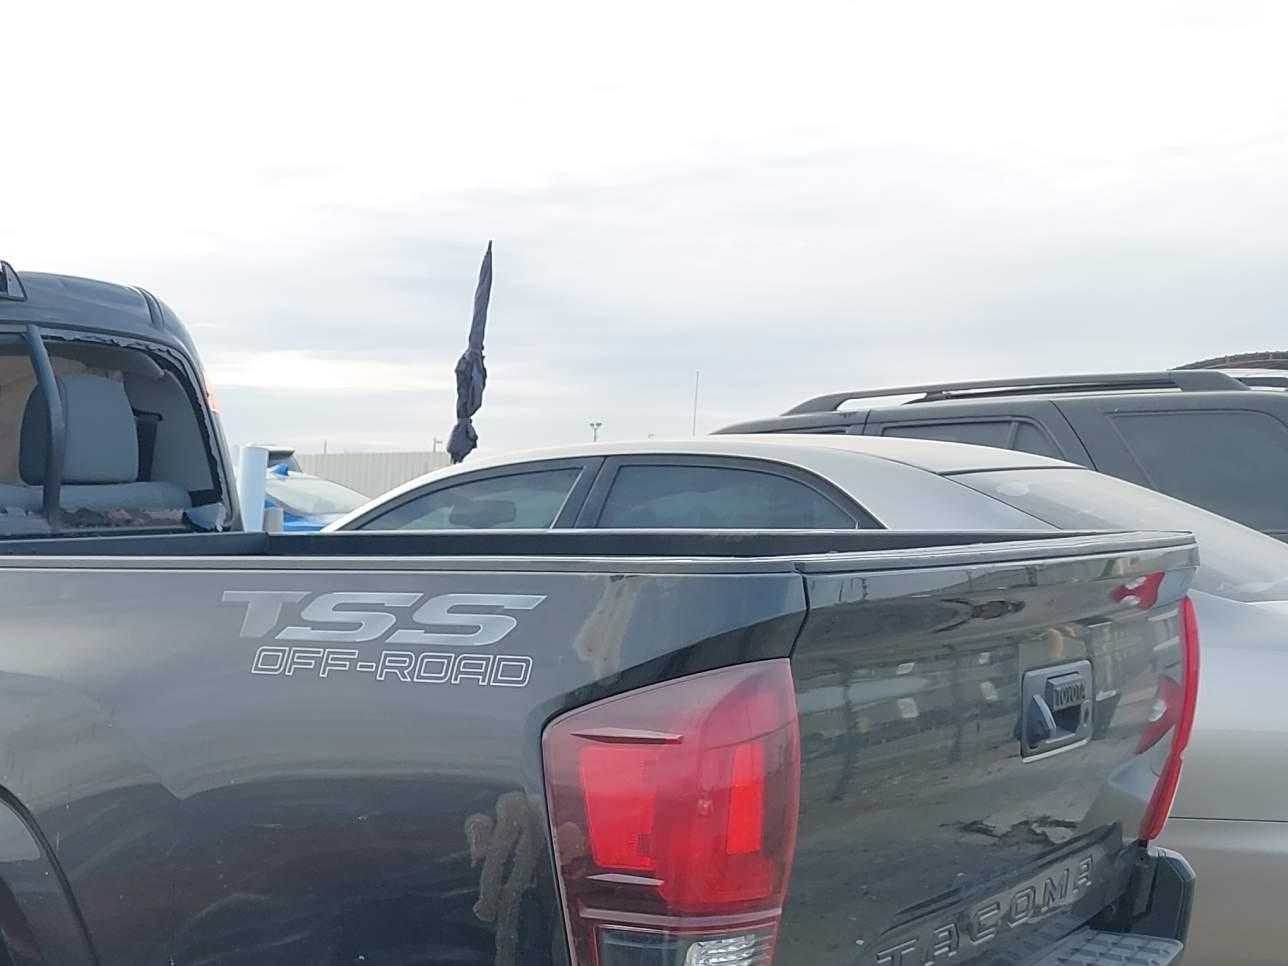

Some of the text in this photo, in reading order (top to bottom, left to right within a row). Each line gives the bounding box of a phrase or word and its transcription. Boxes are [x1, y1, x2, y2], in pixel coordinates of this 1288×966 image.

[222, 591, 548, 646] TSS
[252, 646, 533, 687] OFF-ROAD
[1052, 681, 1086, 708] TOYOTA
